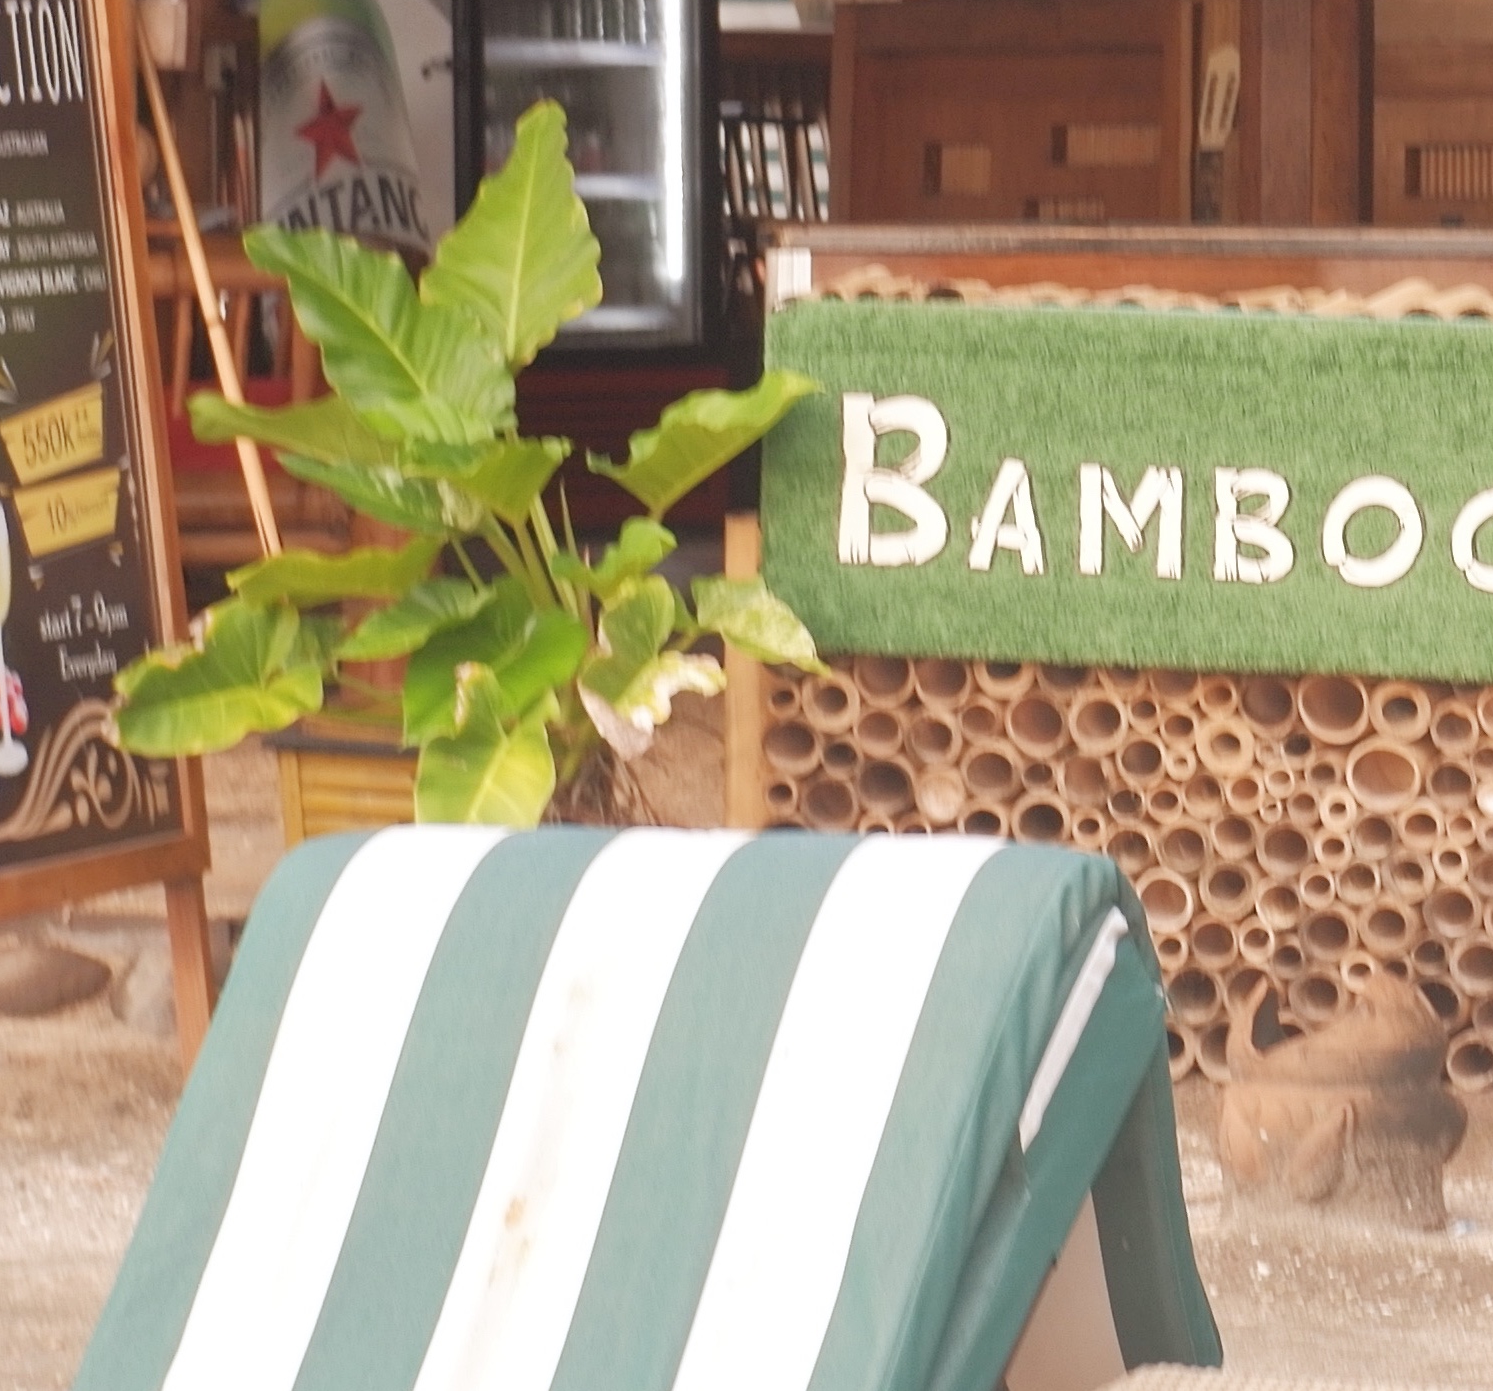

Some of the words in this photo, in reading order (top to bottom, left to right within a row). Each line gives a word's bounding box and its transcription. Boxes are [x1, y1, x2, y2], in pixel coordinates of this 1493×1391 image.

[39, 605, 72, 643] start
[70, 594, 83, 638] 7
[94, 589, 129, 638] 9pm
